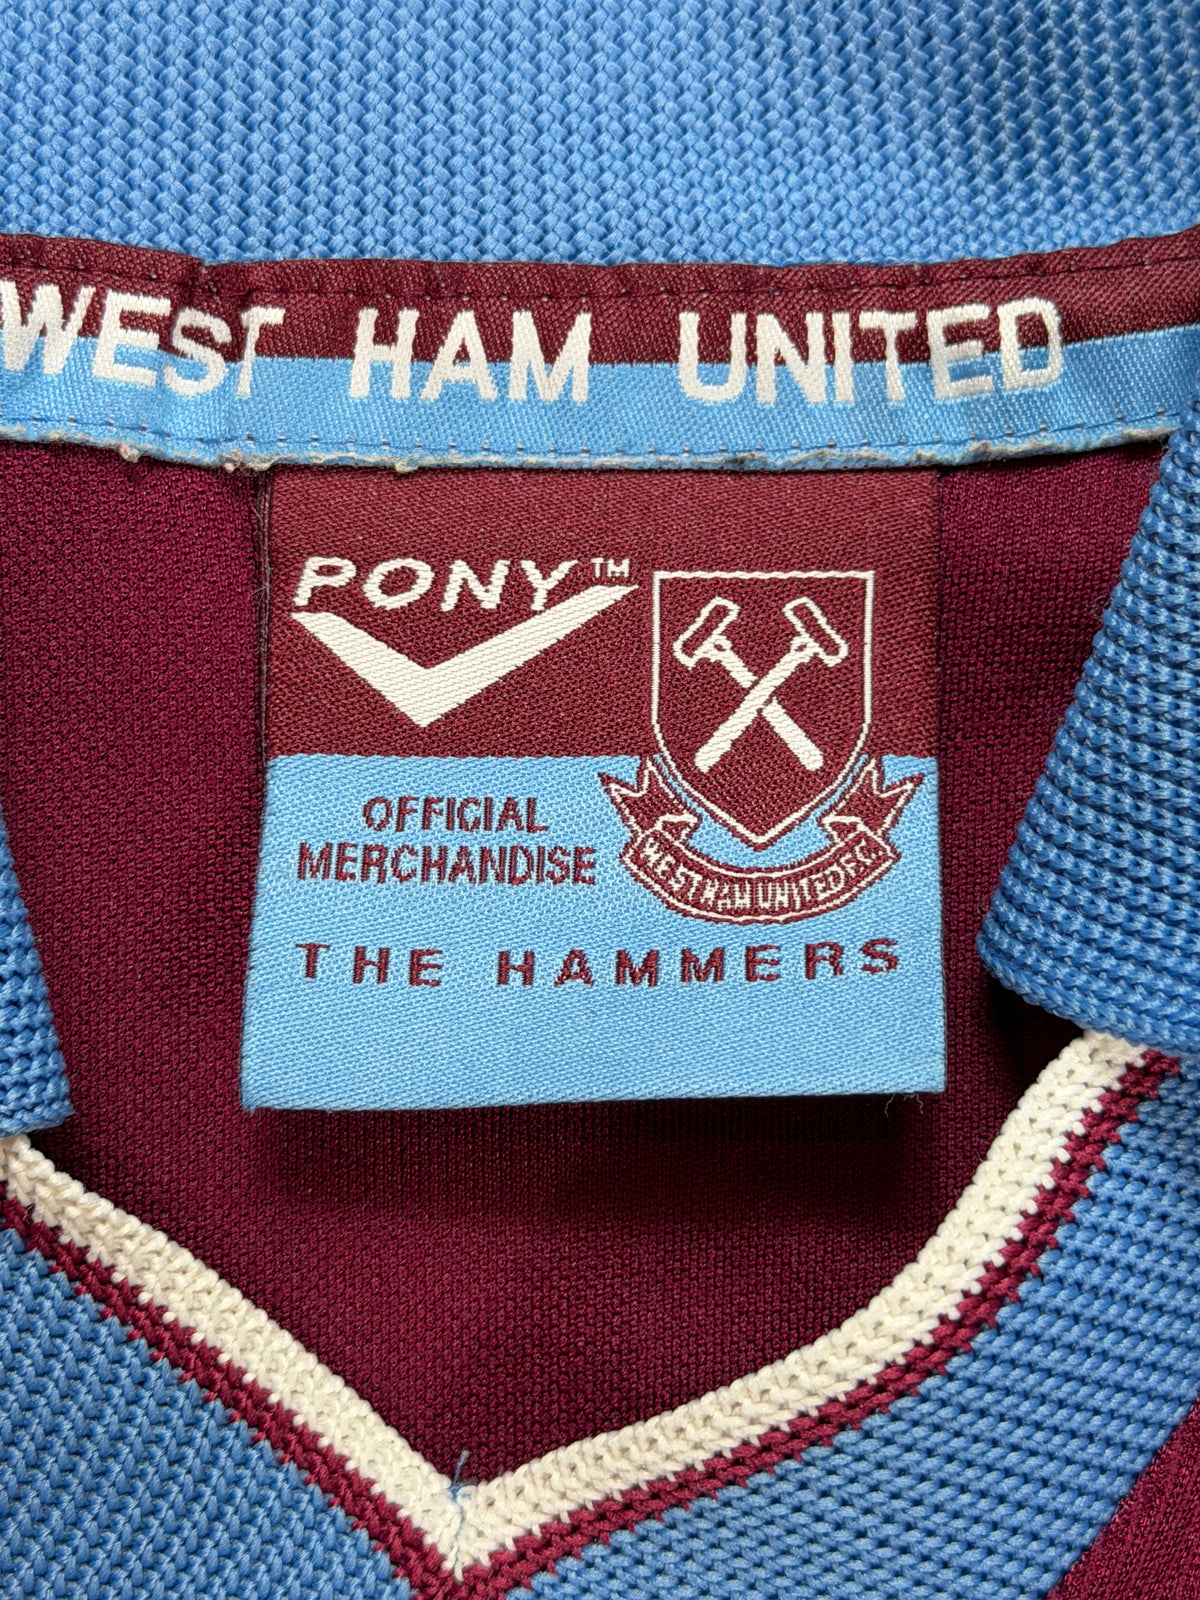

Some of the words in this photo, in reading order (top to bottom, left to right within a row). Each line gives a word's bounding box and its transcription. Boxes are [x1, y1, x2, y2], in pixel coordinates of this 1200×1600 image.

[0, 279, 285, 397] WEST
[350, 307, 592, 403] HAM
[677, 298, 1063, 405] UNITED
[293, 555, 581, 612] PONY
[362, 796, 549, 833] OFFICIAL
[298, 842, 597, 886] MERCHANDISE
[296, 942, 443, 987] THE
[497, 937, 900, 988] HAMMERS
